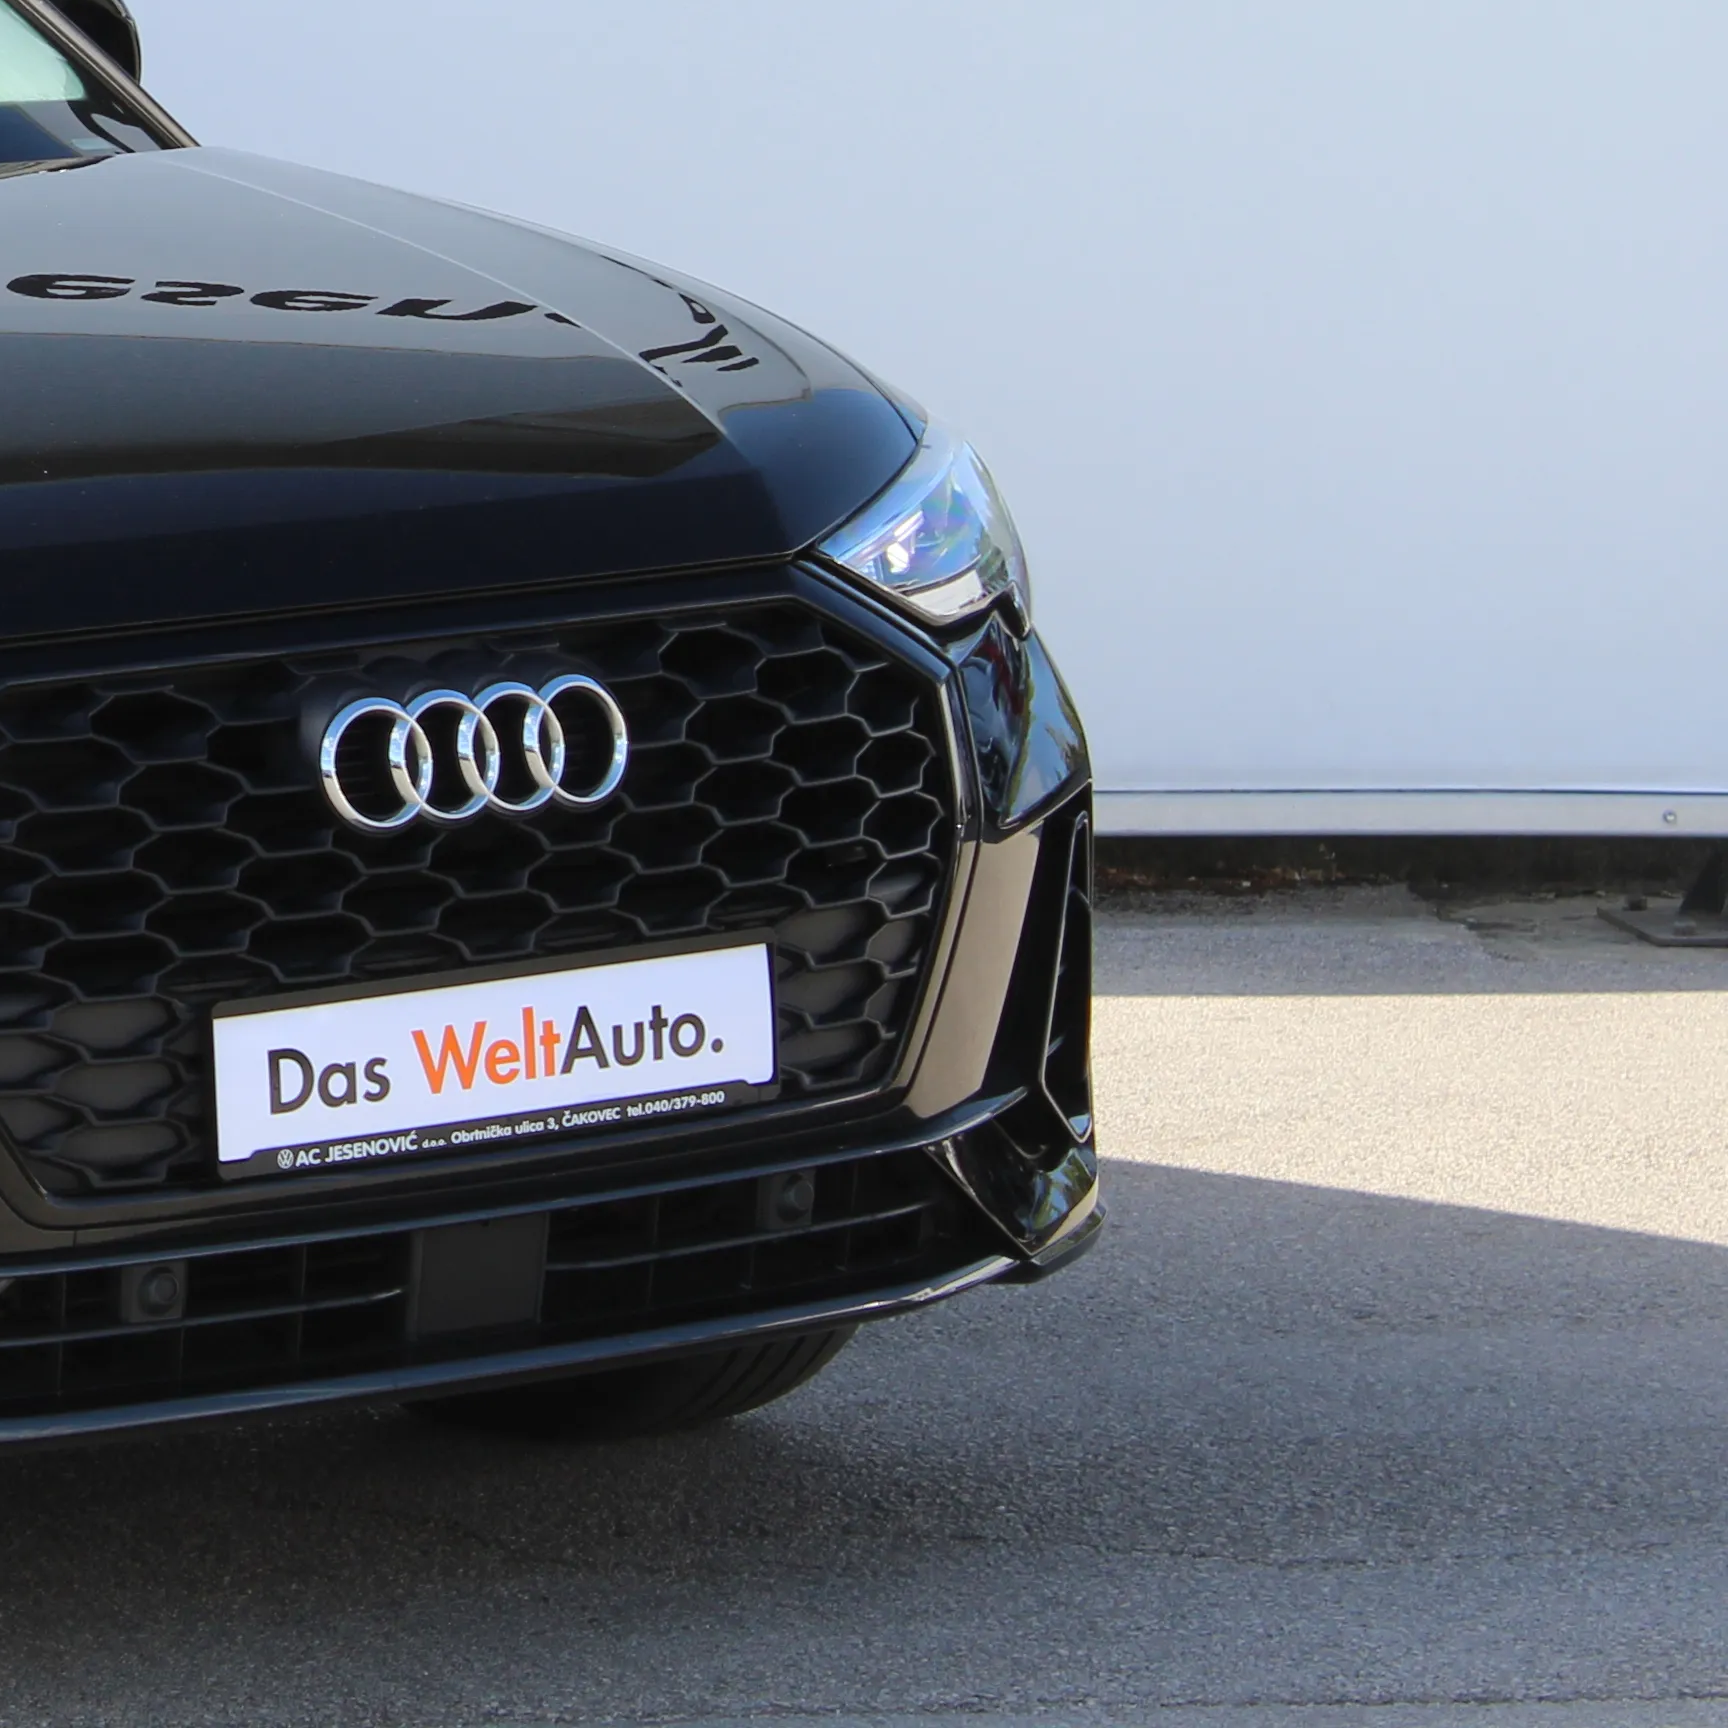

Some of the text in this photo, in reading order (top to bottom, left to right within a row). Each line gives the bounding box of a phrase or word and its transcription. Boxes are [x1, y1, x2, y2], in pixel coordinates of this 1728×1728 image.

[267, 1005, 723, 1114] Das WeltAuto.
[295, 1148, 322, 1167] AC
[325, 1130, 419, 1164] JESENOVIĆ
[451, 1125, 513, 1144] Obrtnička
[515, 1120, 545, 1135] ulica
[562, 1110, 622, 1128] ČAKOVEC
